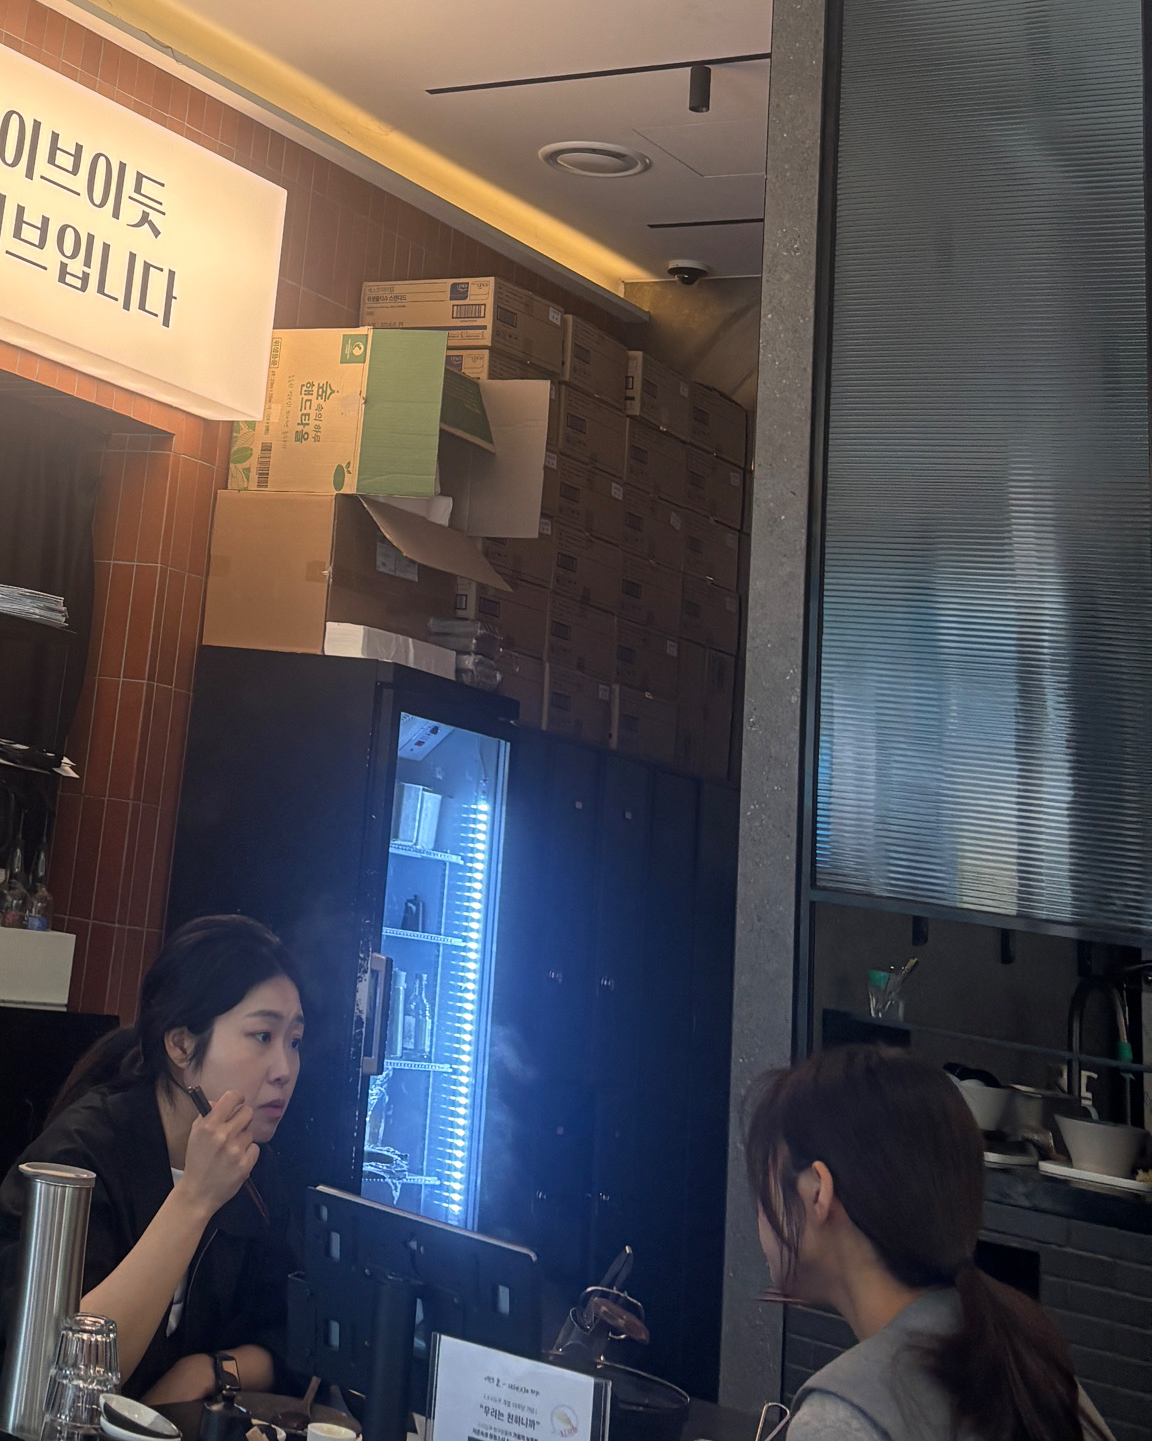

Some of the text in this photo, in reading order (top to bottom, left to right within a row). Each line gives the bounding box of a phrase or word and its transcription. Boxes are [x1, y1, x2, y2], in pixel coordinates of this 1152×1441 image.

[294, 381, 315, 444] 핸드타올
[311, 381, 336, 443] 숲 속의 하루
